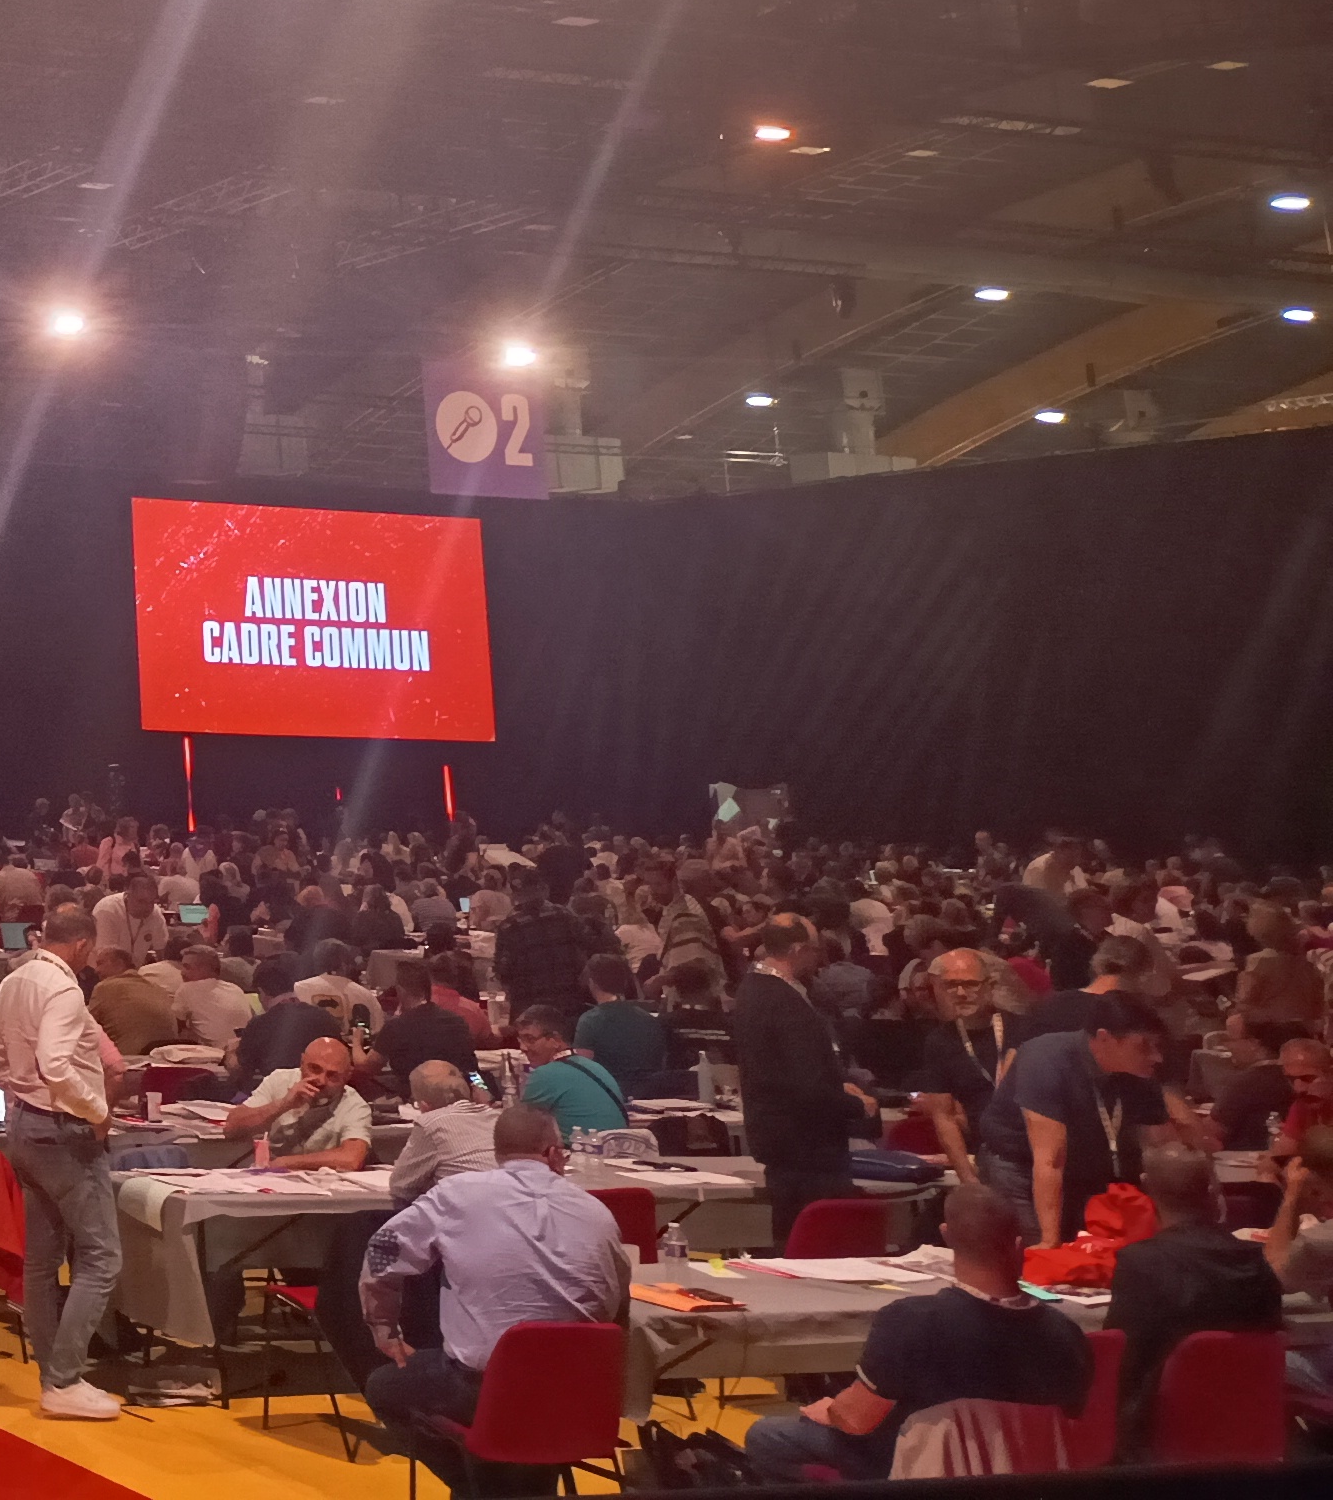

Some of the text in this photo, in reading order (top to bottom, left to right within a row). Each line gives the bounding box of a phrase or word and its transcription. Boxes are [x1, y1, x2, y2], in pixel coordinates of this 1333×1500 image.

[500, 393, 533, 467] 2
[244, 576, 387, 623] ANNEXION
[202, 620, 431, 672] CADRE COMMUN
